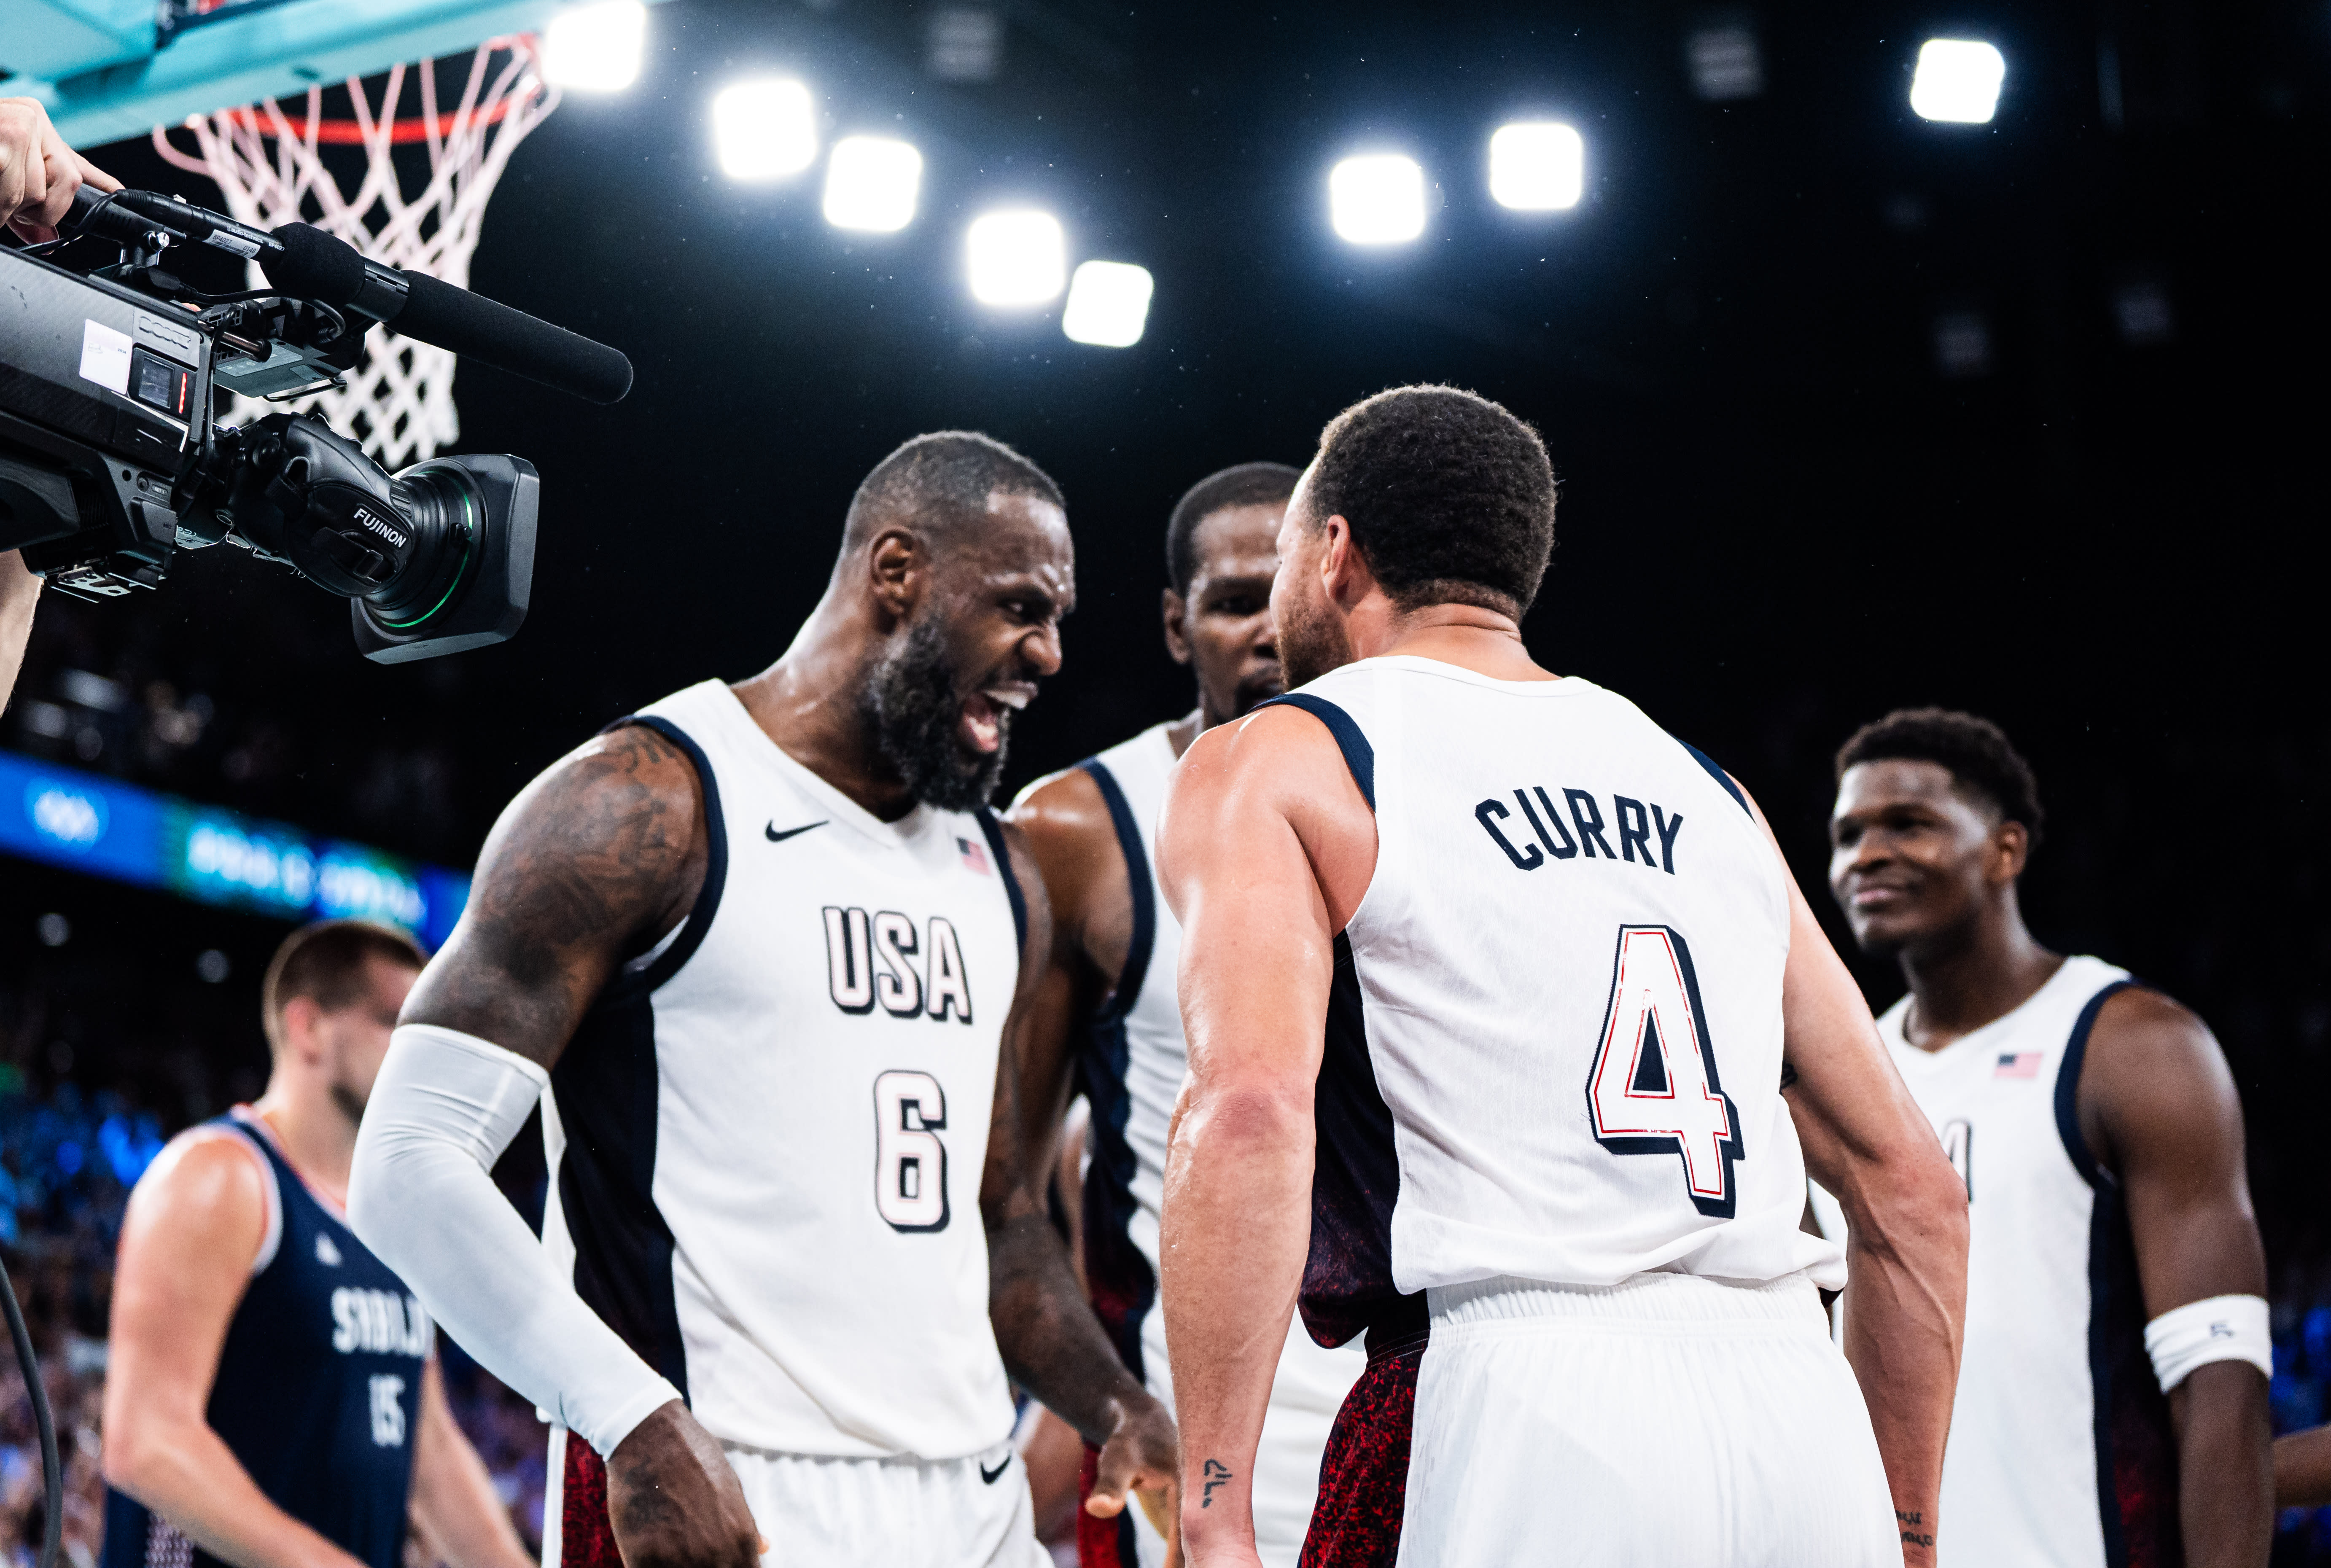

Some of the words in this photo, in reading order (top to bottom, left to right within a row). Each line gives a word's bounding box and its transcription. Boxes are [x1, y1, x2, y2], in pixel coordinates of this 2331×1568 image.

[212, 234, 232, 244] BP4027
[243, 245, 256, 253] 0148
[268, 242, 285, 251] BP4027
[353, 508, 406, 548] FUJINON
[1475, 786, 1684, 875] CURRY
[822, 906, 972, 1025] USA
[1585, 924, 1745, 1219] 4
[873, 1070, 950, 1234] 6
[368, 1373, 406, 1448] 15
